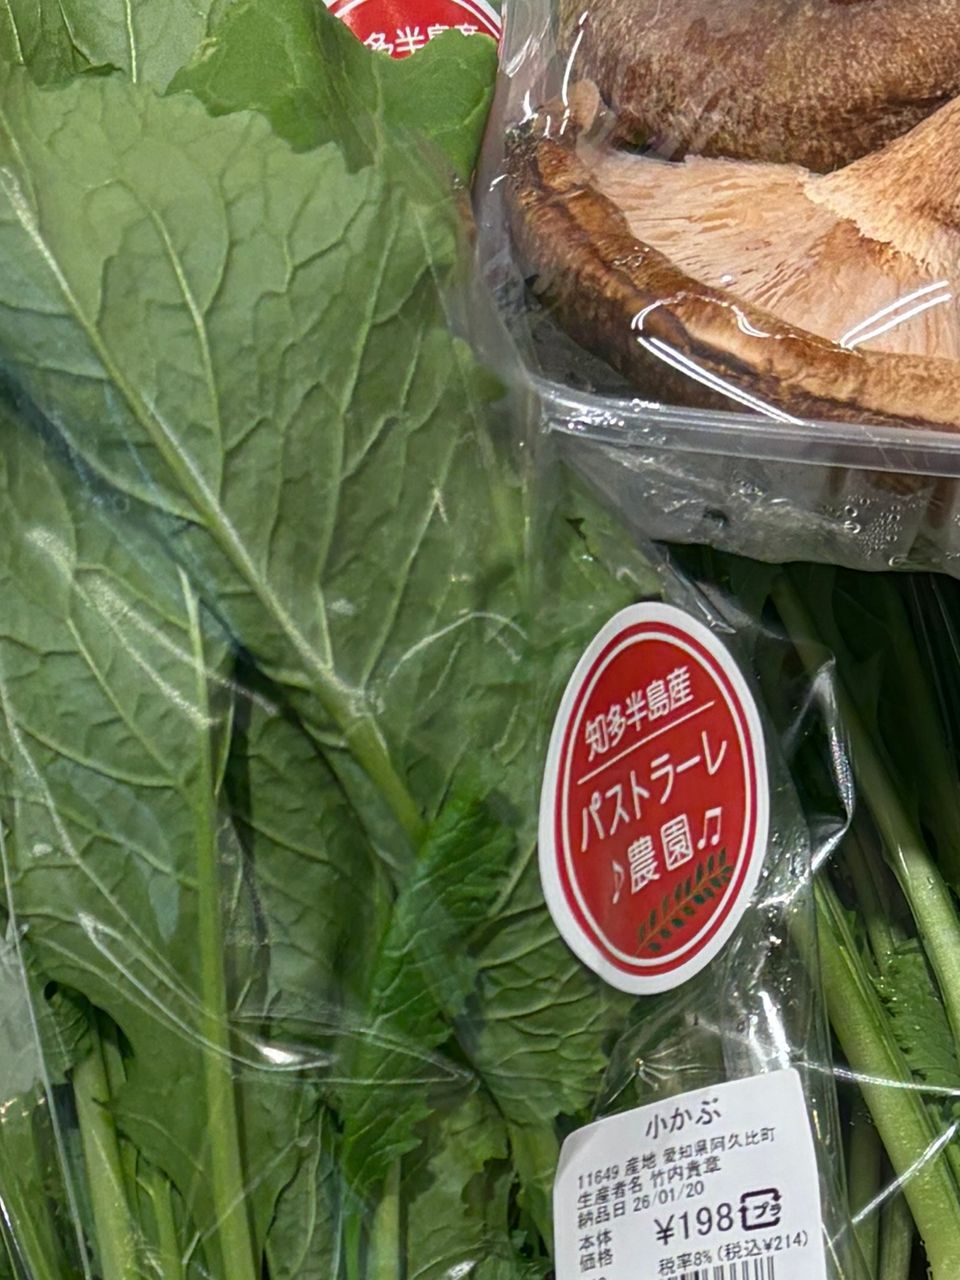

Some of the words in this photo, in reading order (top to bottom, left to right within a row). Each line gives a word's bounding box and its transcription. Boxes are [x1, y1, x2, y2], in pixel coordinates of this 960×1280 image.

[585, 665, 694, 762] 知多半島産
[580, 731, 728, 852] パストラーレ
[644, 1098, 722, 1140] 小かぶ
[578, 1165, 619, 1189] 11649
[625, 1153, 657, 1177] 産地
[663, 1127, 776, 1163] 愛知県阿久比町
[577, 1176, 643, 1210] 生産者名
[578, 1200, 626, 1230] 納品日
[633, 1181, 704, 1213] 26/01/20
[753, 1202, 782, 1219] プラ
[579, 1228, 612, 1251] 本体
[654, 1202, 733, 1245] ¥198
[580, 1248, 613, 1272] 価格
